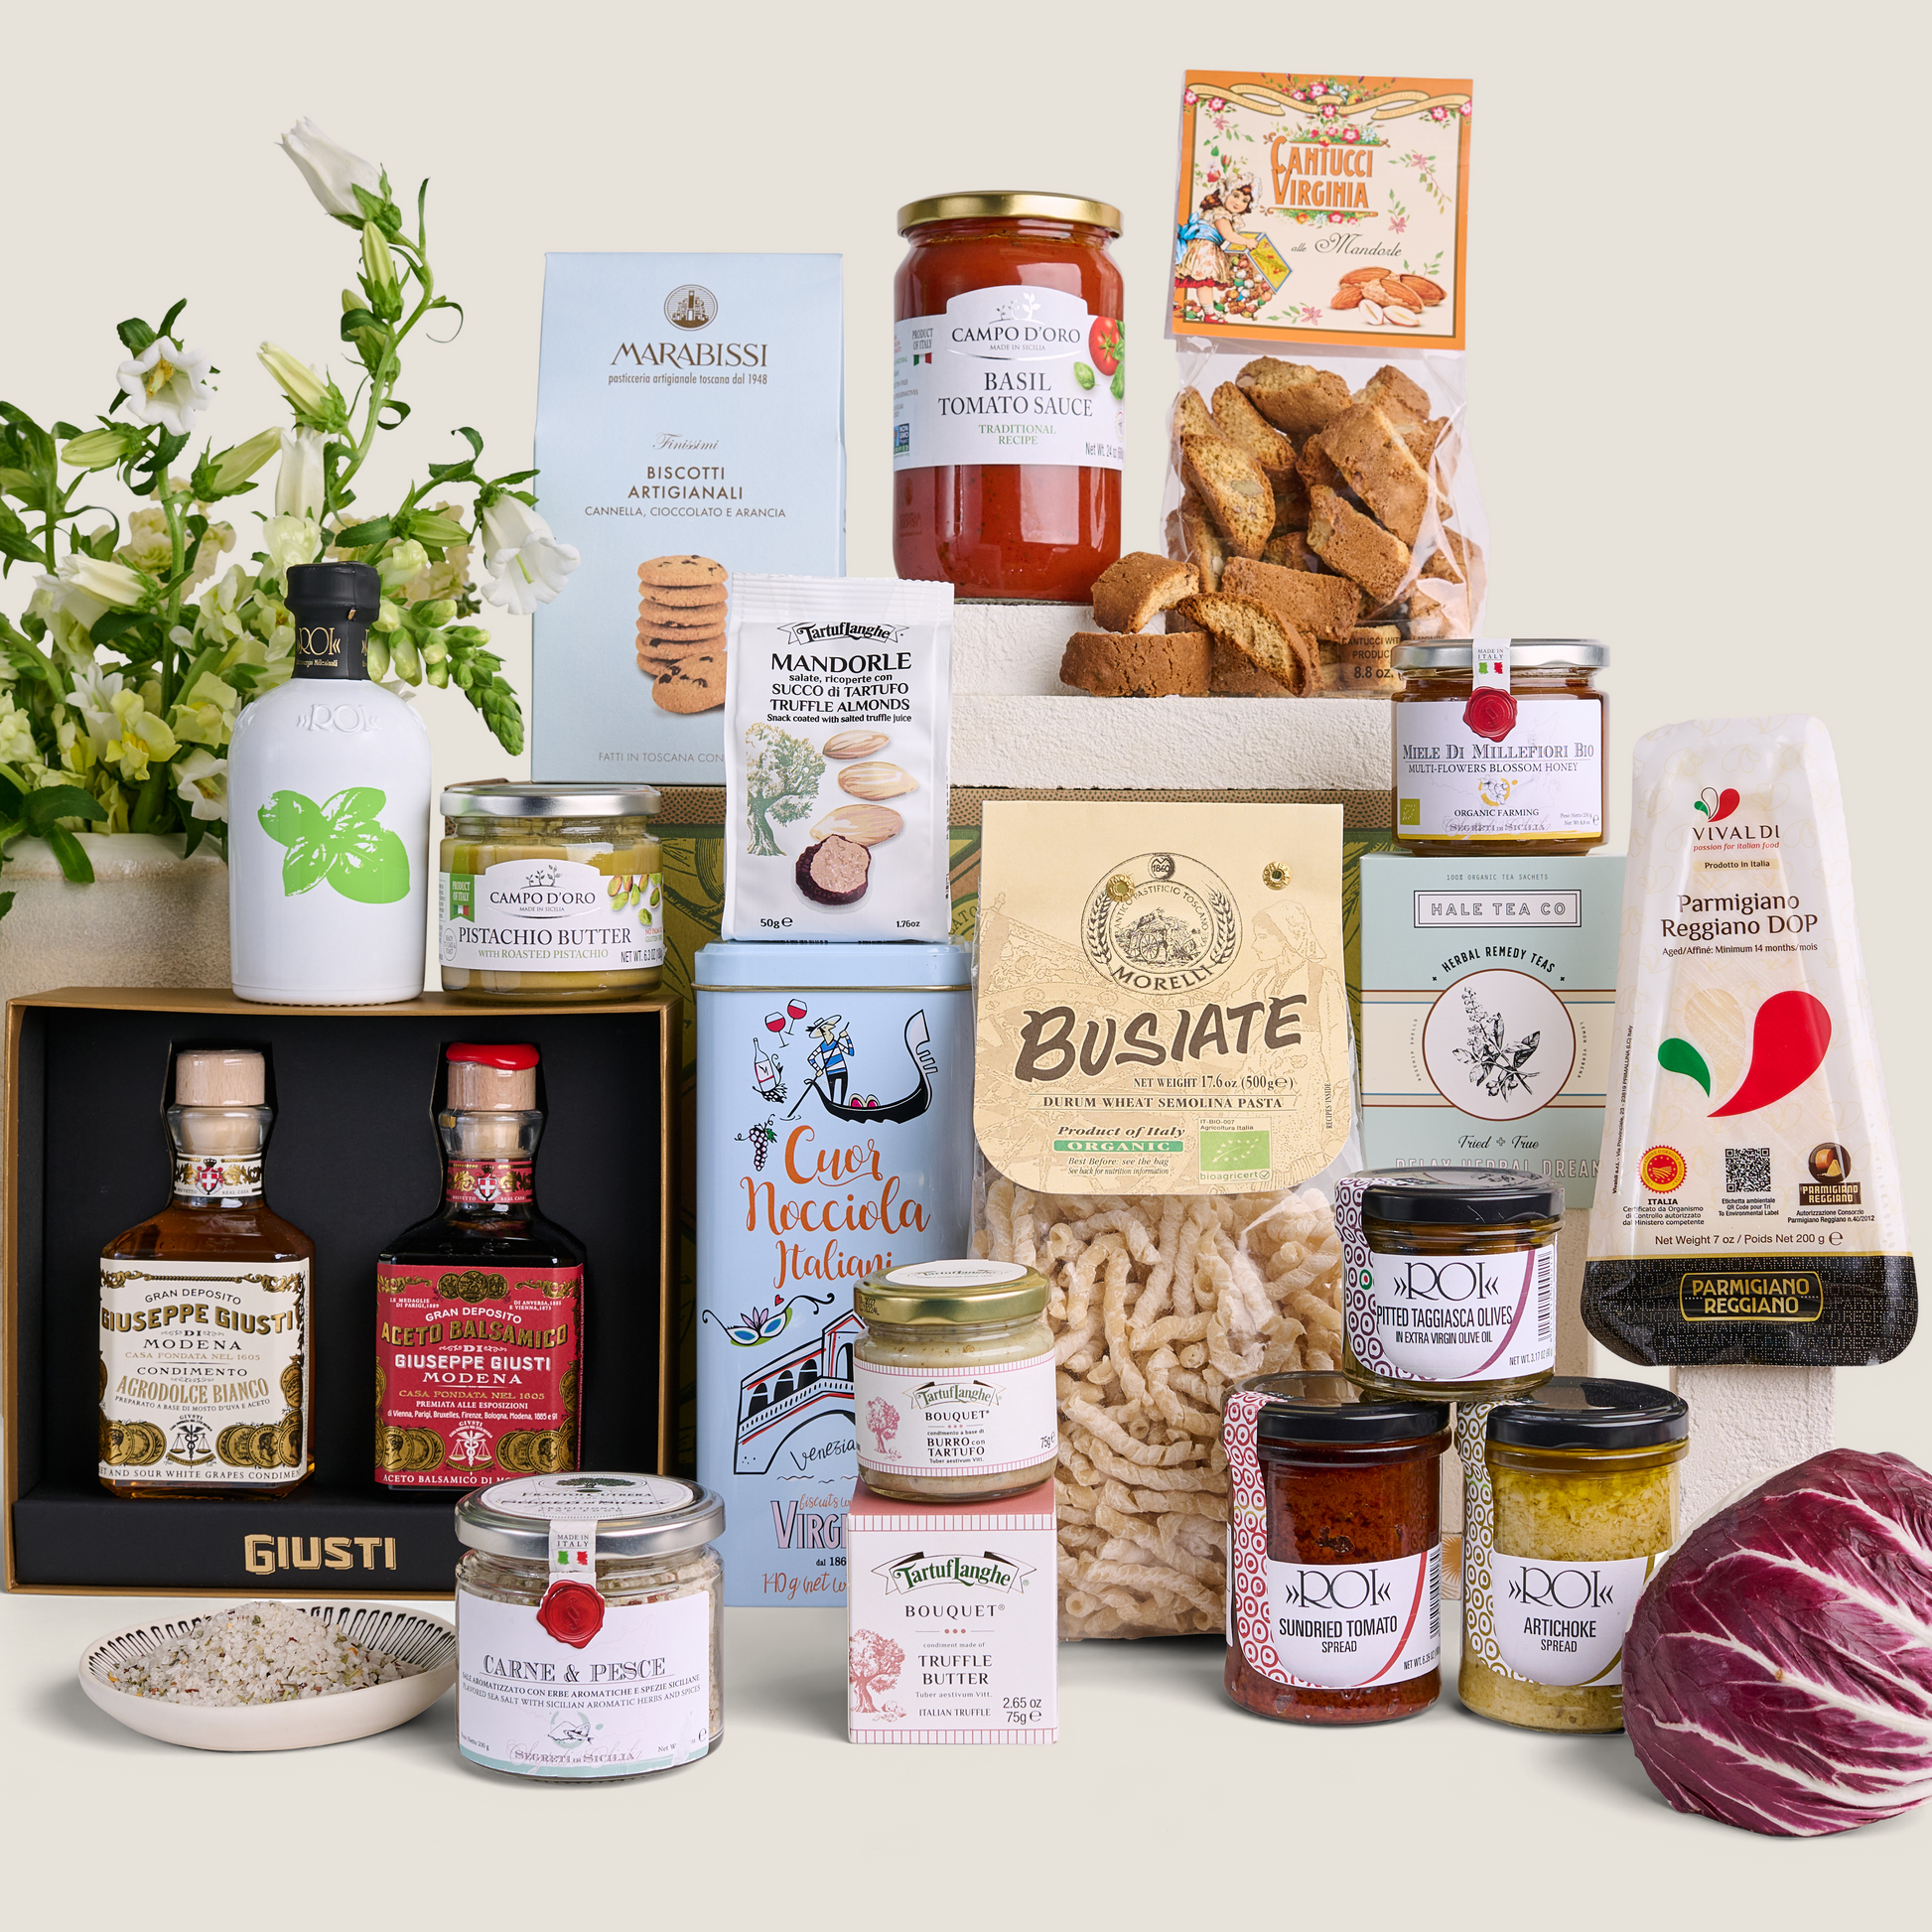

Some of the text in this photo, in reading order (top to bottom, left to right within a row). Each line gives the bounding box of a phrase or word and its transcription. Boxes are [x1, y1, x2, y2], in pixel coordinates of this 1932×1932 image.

[1271, 135, 1373, 178] CANTUCCI
[1272, 169, 1369, 207] VIRGINIA
[1292, 233, 1402, 256] alle Mandorle
[952, 326, 1080, 343] CAMPO D'ORO
[610, 343, 767, 369] MARABISSI
[609, 372, 767, 386] pasticceria artigianale toscana dal 1948
[984, 372, 1051, 391] BASIL
[938, 397, 1092, 416] TOMATO SAUCE
[979, 425, 1056, 434] TRADITIONAL
[999, 436, 1037, 445] RECIPE
[647, 467, 725, 480] BISCOTTI
[628, 485, 743, 499] ARTIGIANALI
[585, 506, 785, 517] CANNELLA, CIOCCOLATO E ARANCIA
[771, 652, 911, 673] MANDORLE
[1354, 666, 1393, 678] 8.8 oz.
[825, 675, 871, 684] ricoperte
[772, 683, 908, 697] SUCCO di TARTUFO
[770, 699, 909, 712] TRUFFLE ALMONDS
[767, 713, 791, 722] Snack
[793, 714, 819, 723] coated
[893, 714, 911, 723] juice
[599, 753, 724, 762] FATTI IN TOSCANA CON
[1545, 762, 1578, 771] HONEY
[1693, 825, 1779, 841] VIVALDI
[1693, 843, 1722, 852] passion
[490, 893, 596, 903] CAMPO D'ORO
[1678, 894, 1799, 914] Parmigiano
[1431, 902, 1566, 916] HALE TEA CO
[897, 919, 920, 928] 1.76oz
[1661, 914, 1818, 941] Reggiano DOP
[459, 927, 631, 945] PISTACHIO BUTTER
[501, 949, 550, 958] ROASTED
[553, 949, 609, 958] PISTACHIO
[1442, 946, 1555, 974] HERBAL REMEDY TEAS
[1111, 965, 1214, 991] MORELLI
[1015, 995, 1307, 1082] BUSIATE
[1134, 1076, 1237, 1088] NET WEIGHT 17.6 oz
[1043, 1097, 1282, 1108] DURUM WHEAT SEMOLINA PASTA
[1057, 1126, 1184, 1138] Product of Italy
[1068, 1141, 1170, 1151] ORGANIC
[785, 1125, 883, 1187] Cuor
[1200, 1170, 1258, 1180] bioagricert
[740, 1175, 930, 1235] Nocciola
[1692, 1278, 1809, 1296] PARMIGIANO
[1704, 1297, 1799, 1313] REGGIANO
[101, 1304, 293, 1334] GIUSEPPE GIUSTI
[1377, 1306, 1512, 1327] PITTED TAGGIASCA OLIVES
[381, 1319, 568, 1349] ACETO BALSAMICO
[1396, 1331, 1492, 1343] IN EXTRA VIRGIN OLIVE OIL
[143, 1339, 241, 1350] MODENA
[395, 1354, 551, 1371] GIUSEPPE GIUSTI
[137, 1367, 247, 1376] CONDIMENTO
[423, 1372, 522, 1384] MODENA
[116, 1375, 269, 1404] AGRODOLCE BIANCO
[927, 1438, 970, 1447] BURRO
[927, 1447, 985, 1456] TARTUFO
[244, 1534, 396, 1575] GIUSTI
[1280, 1616, 1398, 1638] SUNDRIED TOMATO
[1524, 1617, 1596, 1637] ARTICHOKE
[1321, 1641, 1356, 1653] SPREAD
[1541, 1639, 1577, 1652] SPREAD
[918, 1655, 992, 1667] TRUFFLE
[483, 1655, 665, 1682] CARNE & PESCE
[923, 1673, 989, 1685] BUTTER
[1003, 1697, 1027, 1709] 2.65
